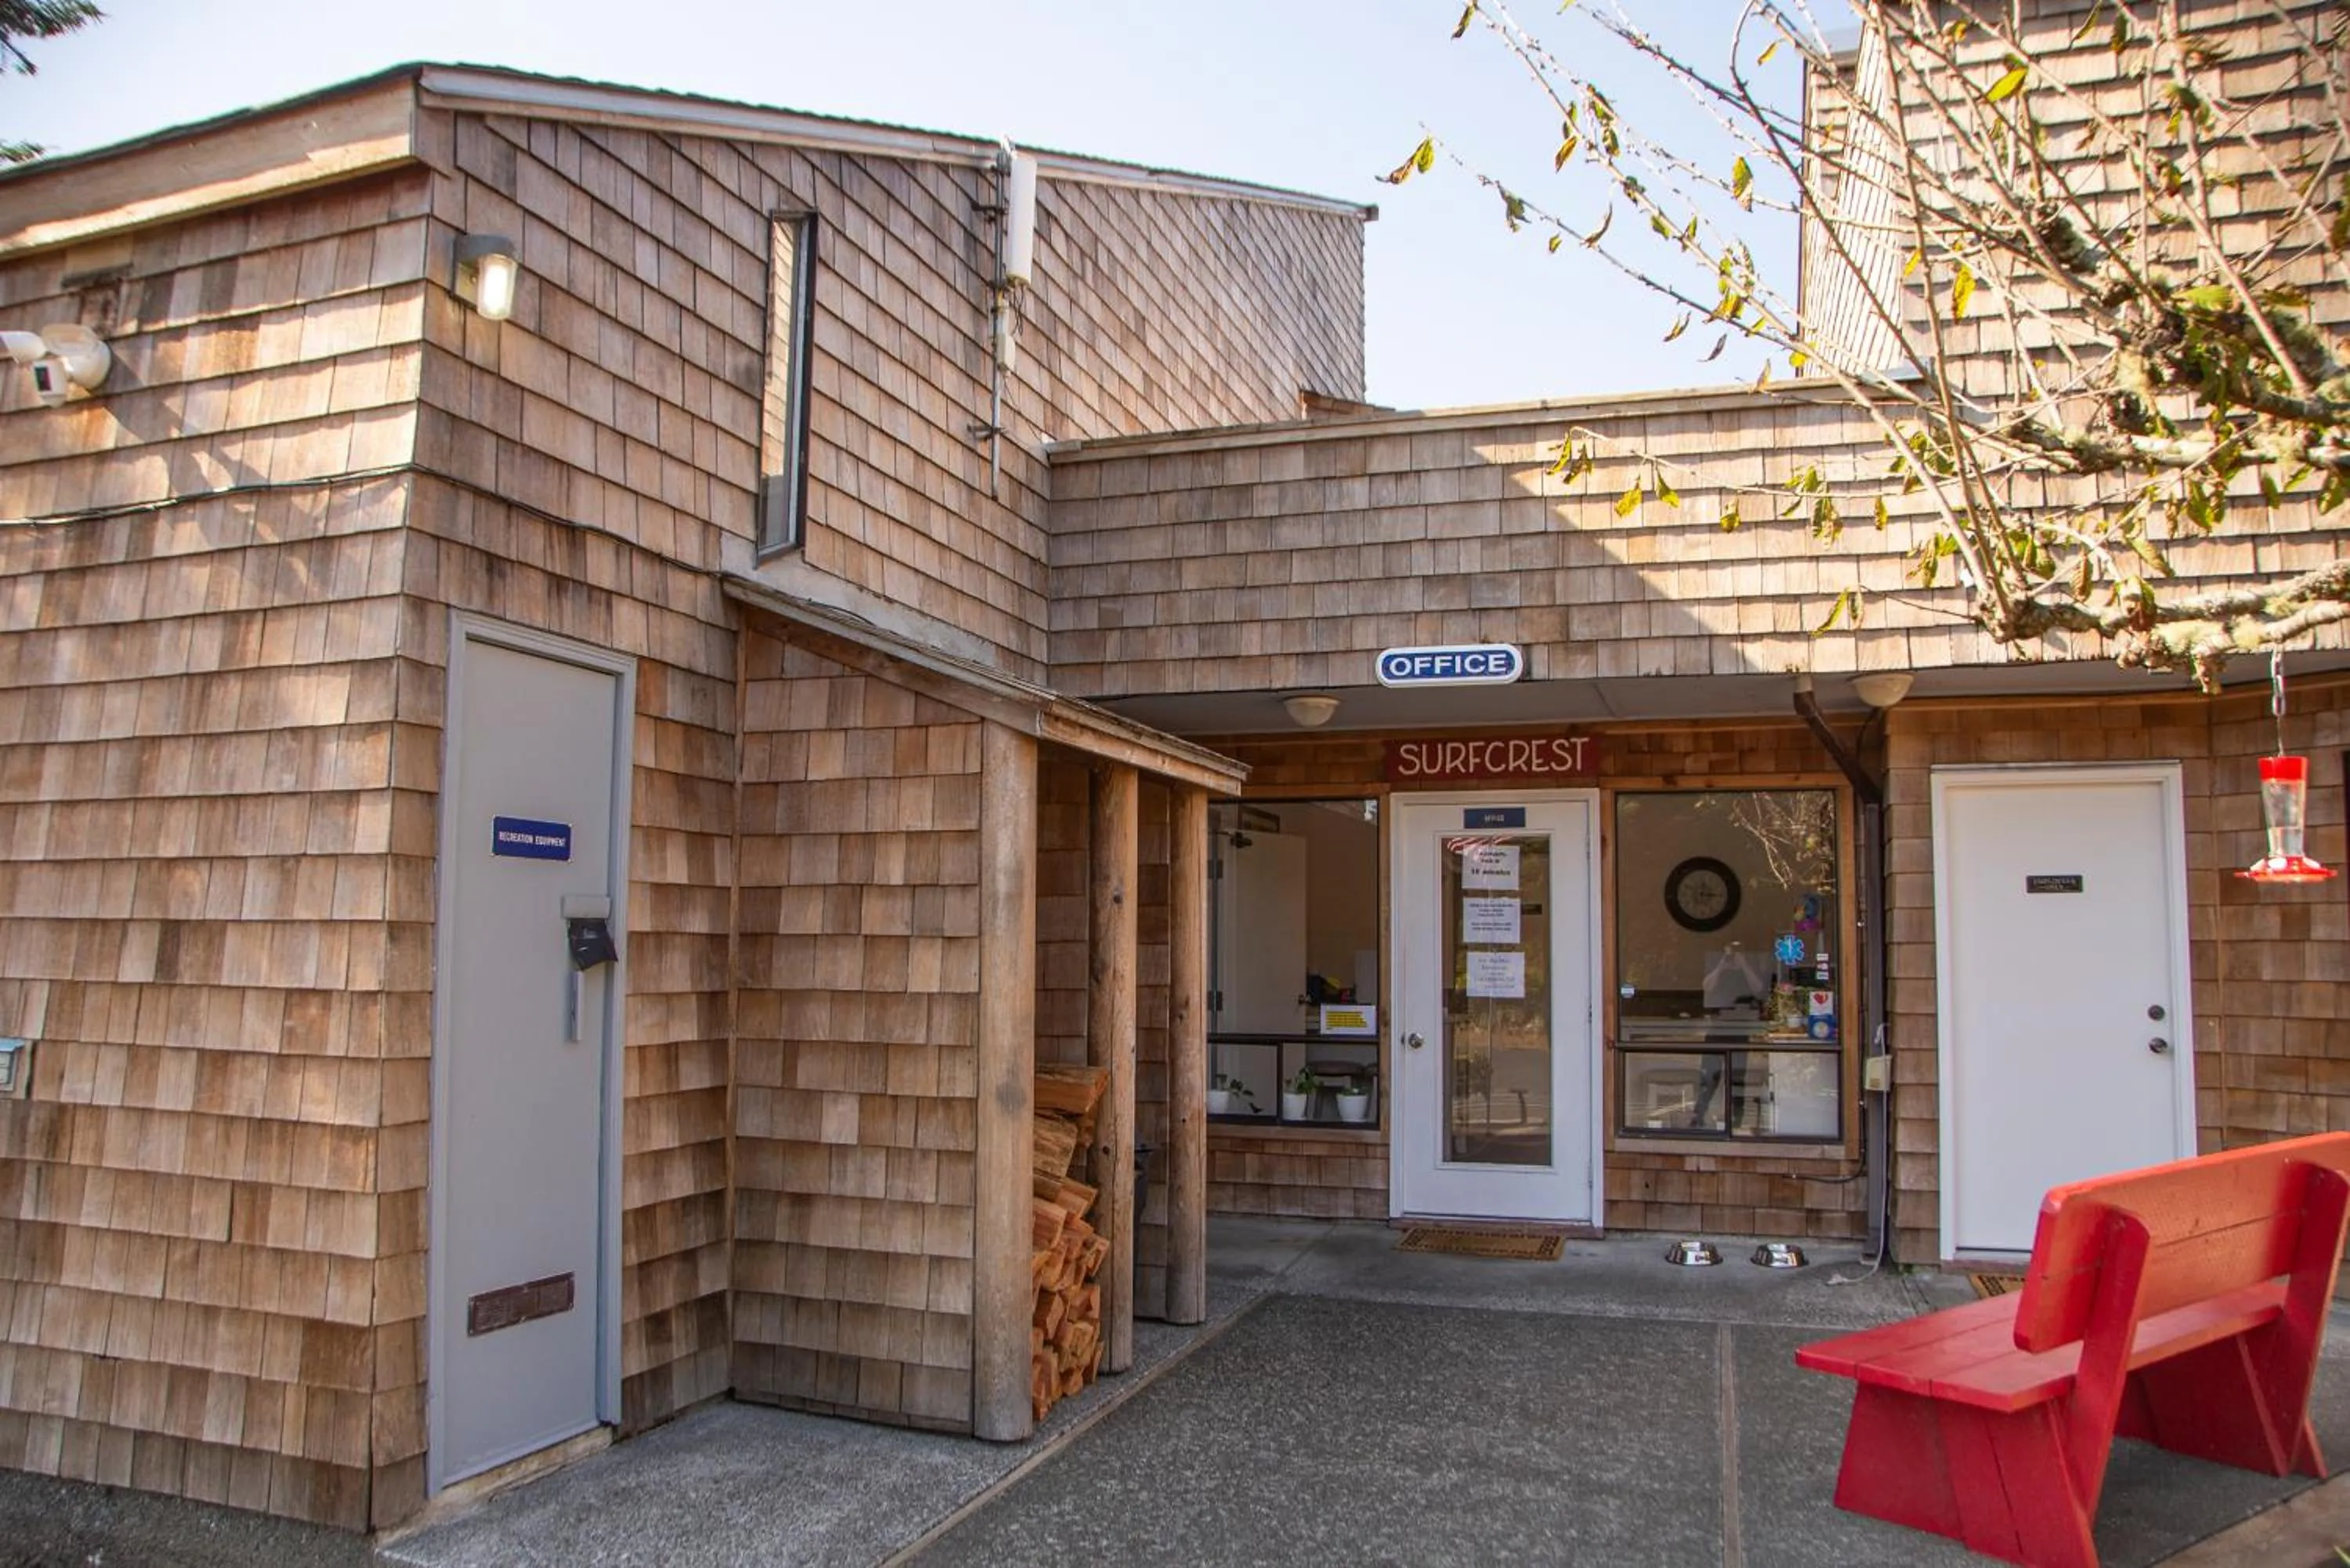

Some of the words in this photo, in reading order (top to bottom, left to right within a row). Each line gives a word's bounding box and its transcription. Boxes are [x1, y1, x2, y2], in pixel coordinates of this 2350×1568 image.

[1389, 652, 1509, 677] OFFICE
[1398, 737, 1590, 775] SURFCREST
[499, 831, 533, 844] RECREATION
[535, 836, 566, 847] EQUIPMENT
